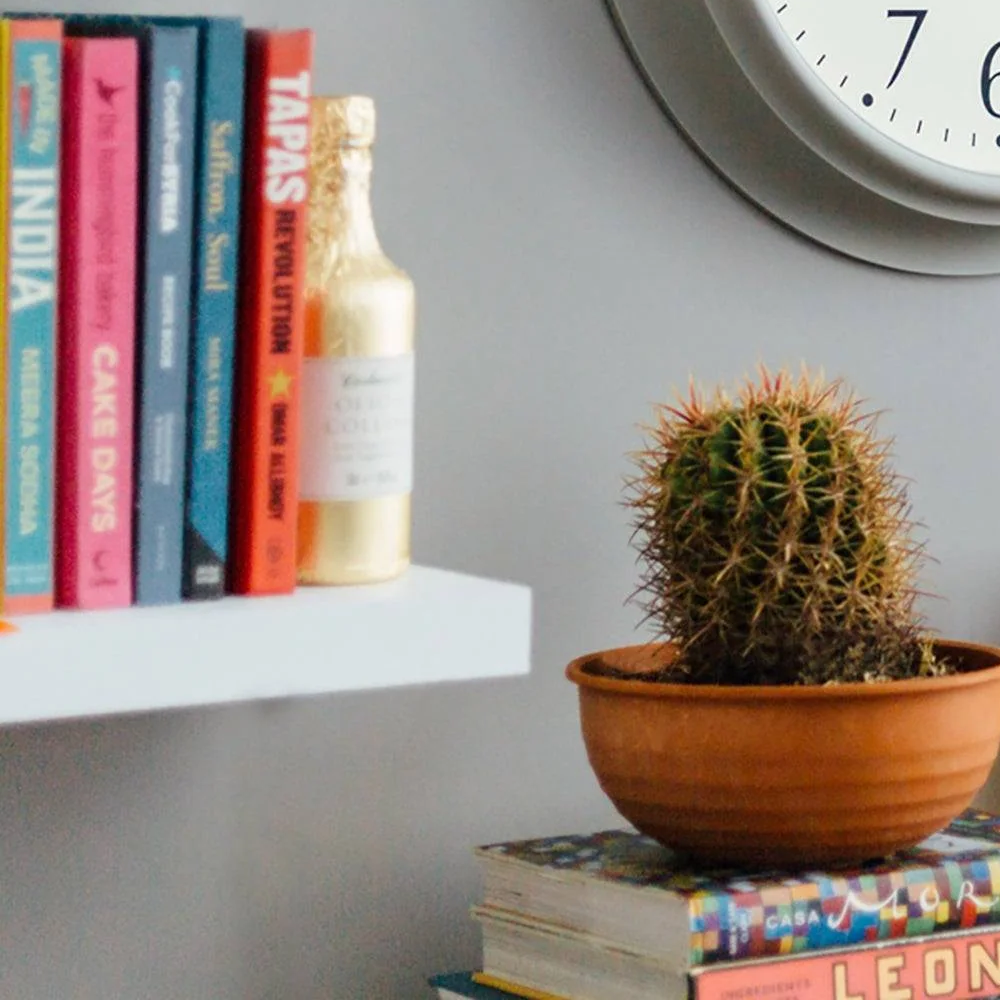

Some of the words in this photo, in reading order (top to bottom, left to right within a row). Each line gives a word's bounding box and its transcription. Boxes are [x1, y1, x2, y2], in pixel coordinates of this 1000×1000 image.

[887, 9, 928, 90] 7
[265, 70, 312, 204] TAPAS
[11, 168, 55, 313] INDIA
[204, 232, 229, 292] Soul
[271, 208, 296, 354] REVOLUTION
[20, 347, 41, 438] MEERA
[91, 345, 119, 438] CAKE
[90, 448, 117, 533] DAYS
[765, 910, 821, 929] CASA
